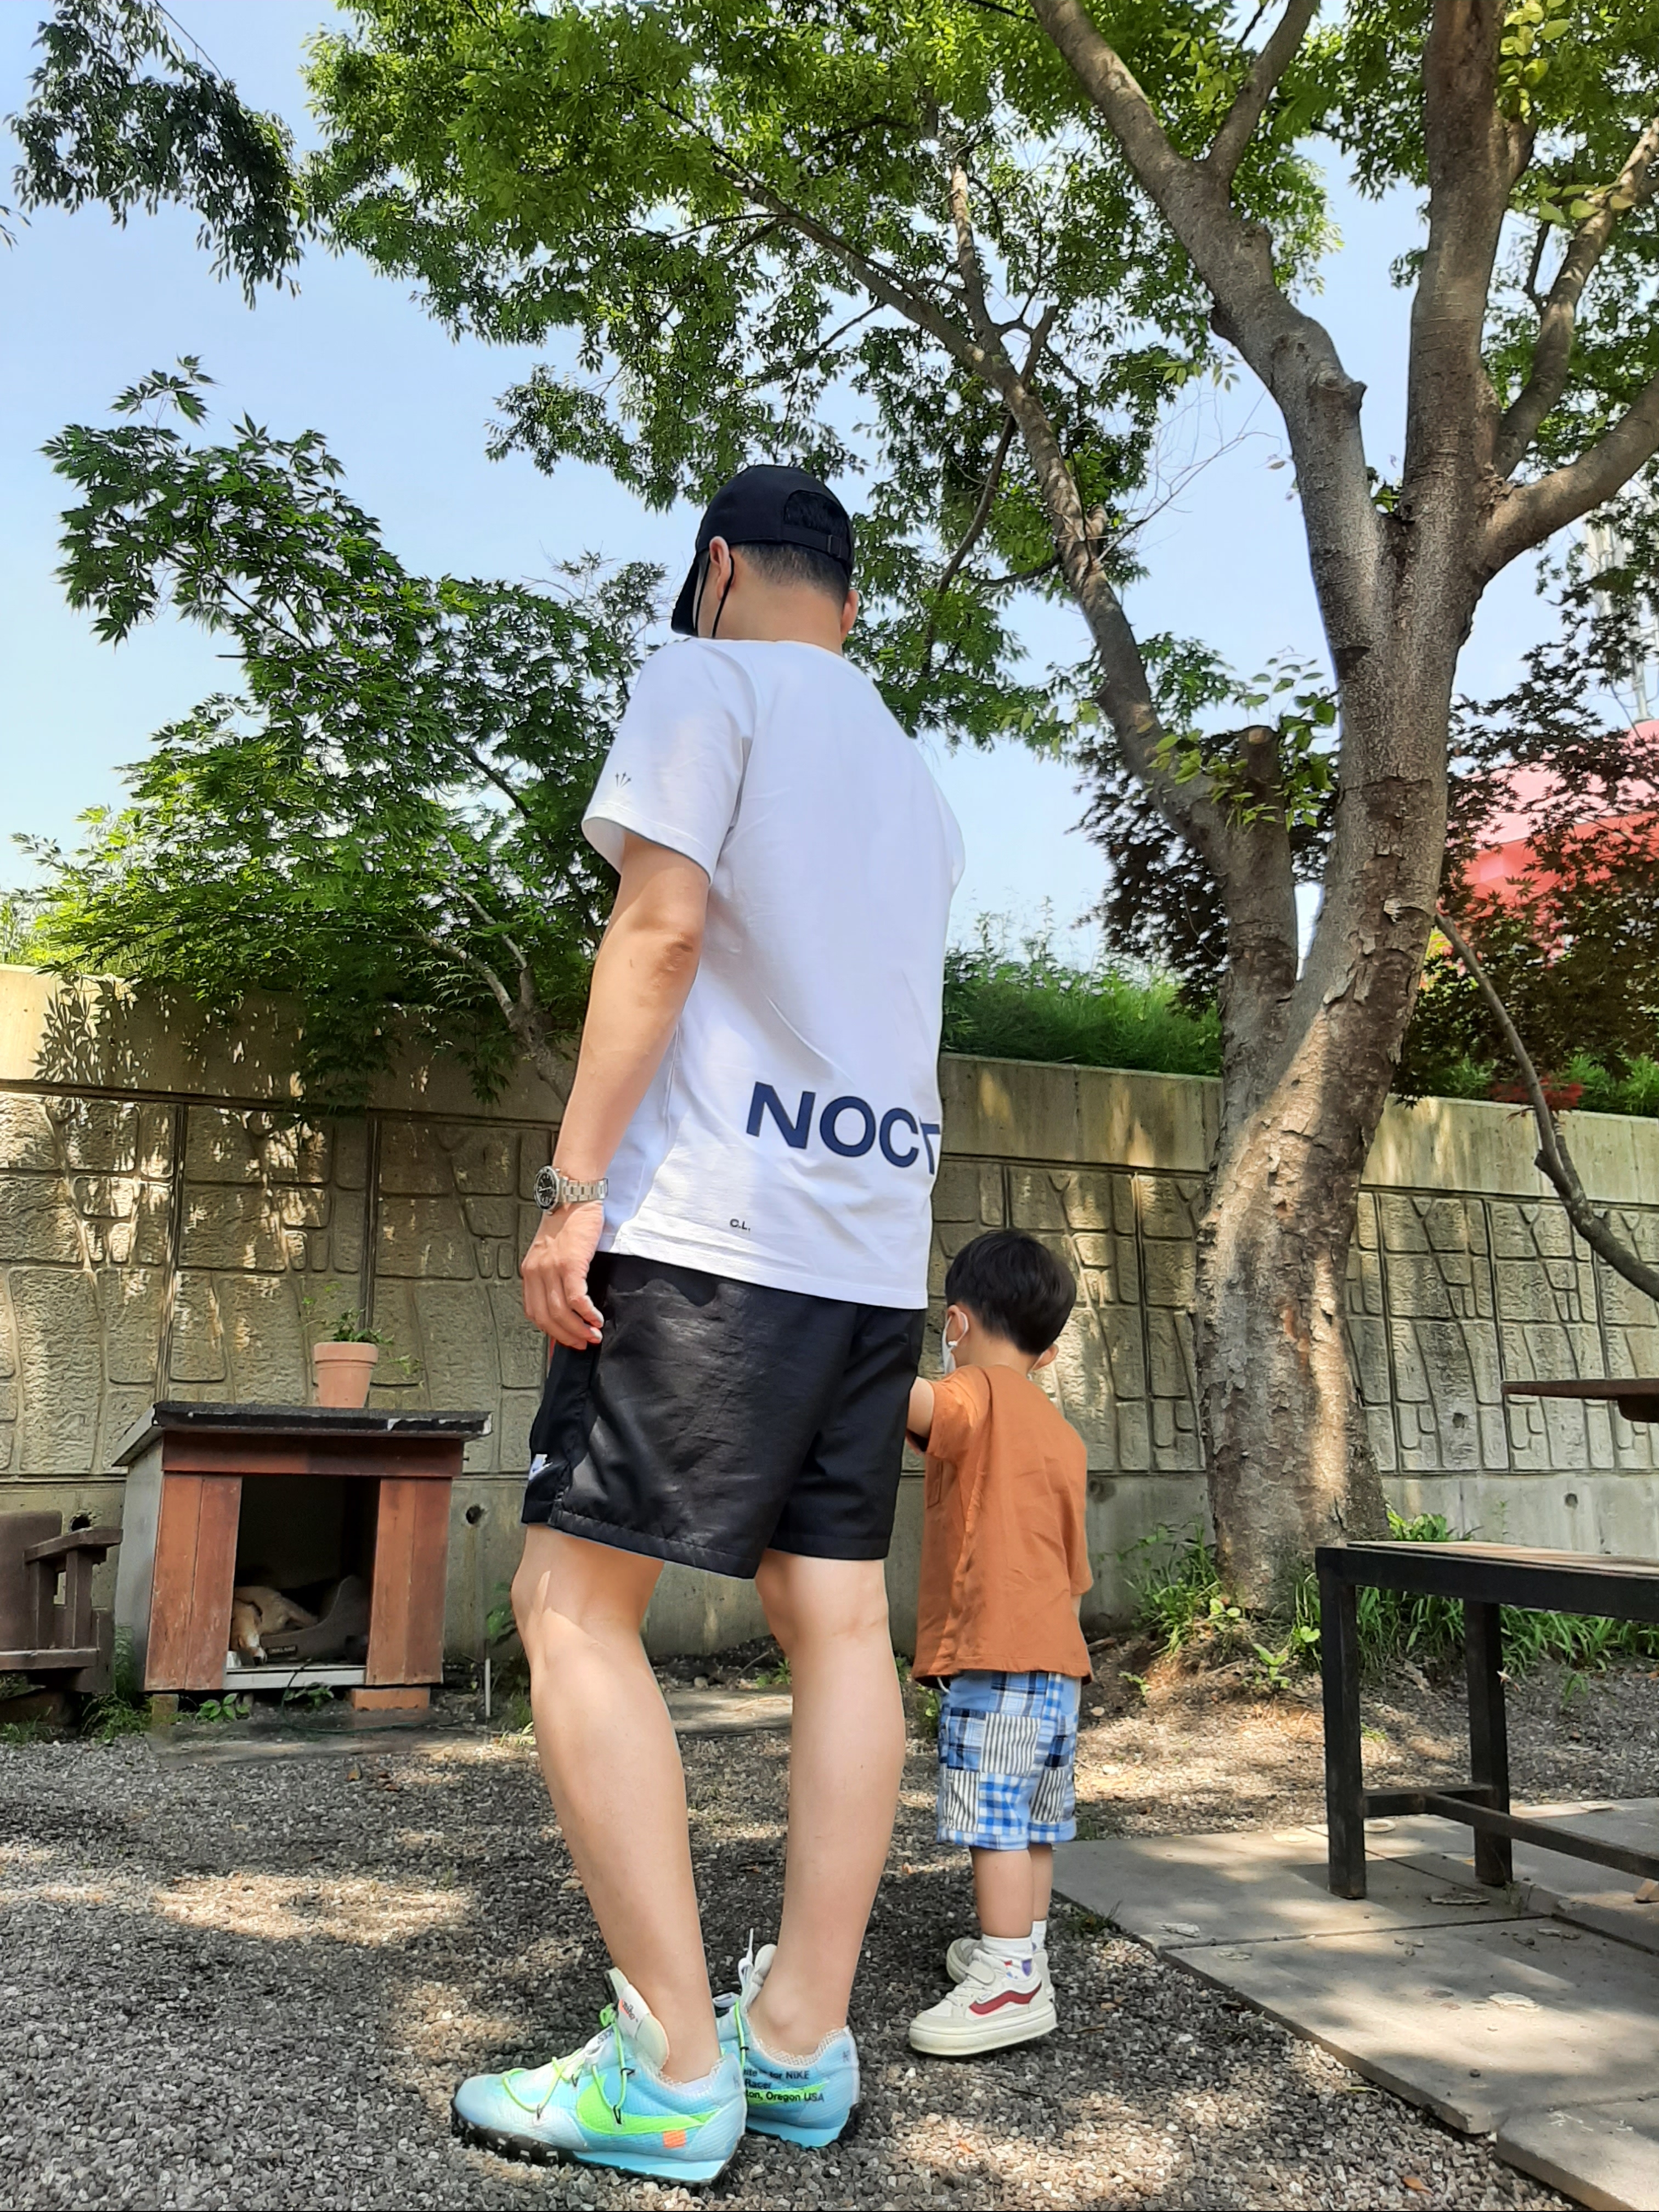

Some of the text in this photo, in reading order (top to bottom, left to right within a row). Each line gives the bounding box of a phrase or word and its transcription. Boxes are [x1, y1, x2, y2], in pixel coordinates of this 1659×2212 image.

[730, 1218, 751, 1231] C.L.
[786, 2070, 809, 2079] NIKE
[766, 2091, 801, 2102] Oregon
[804, 2092, 825, 2102] USA
